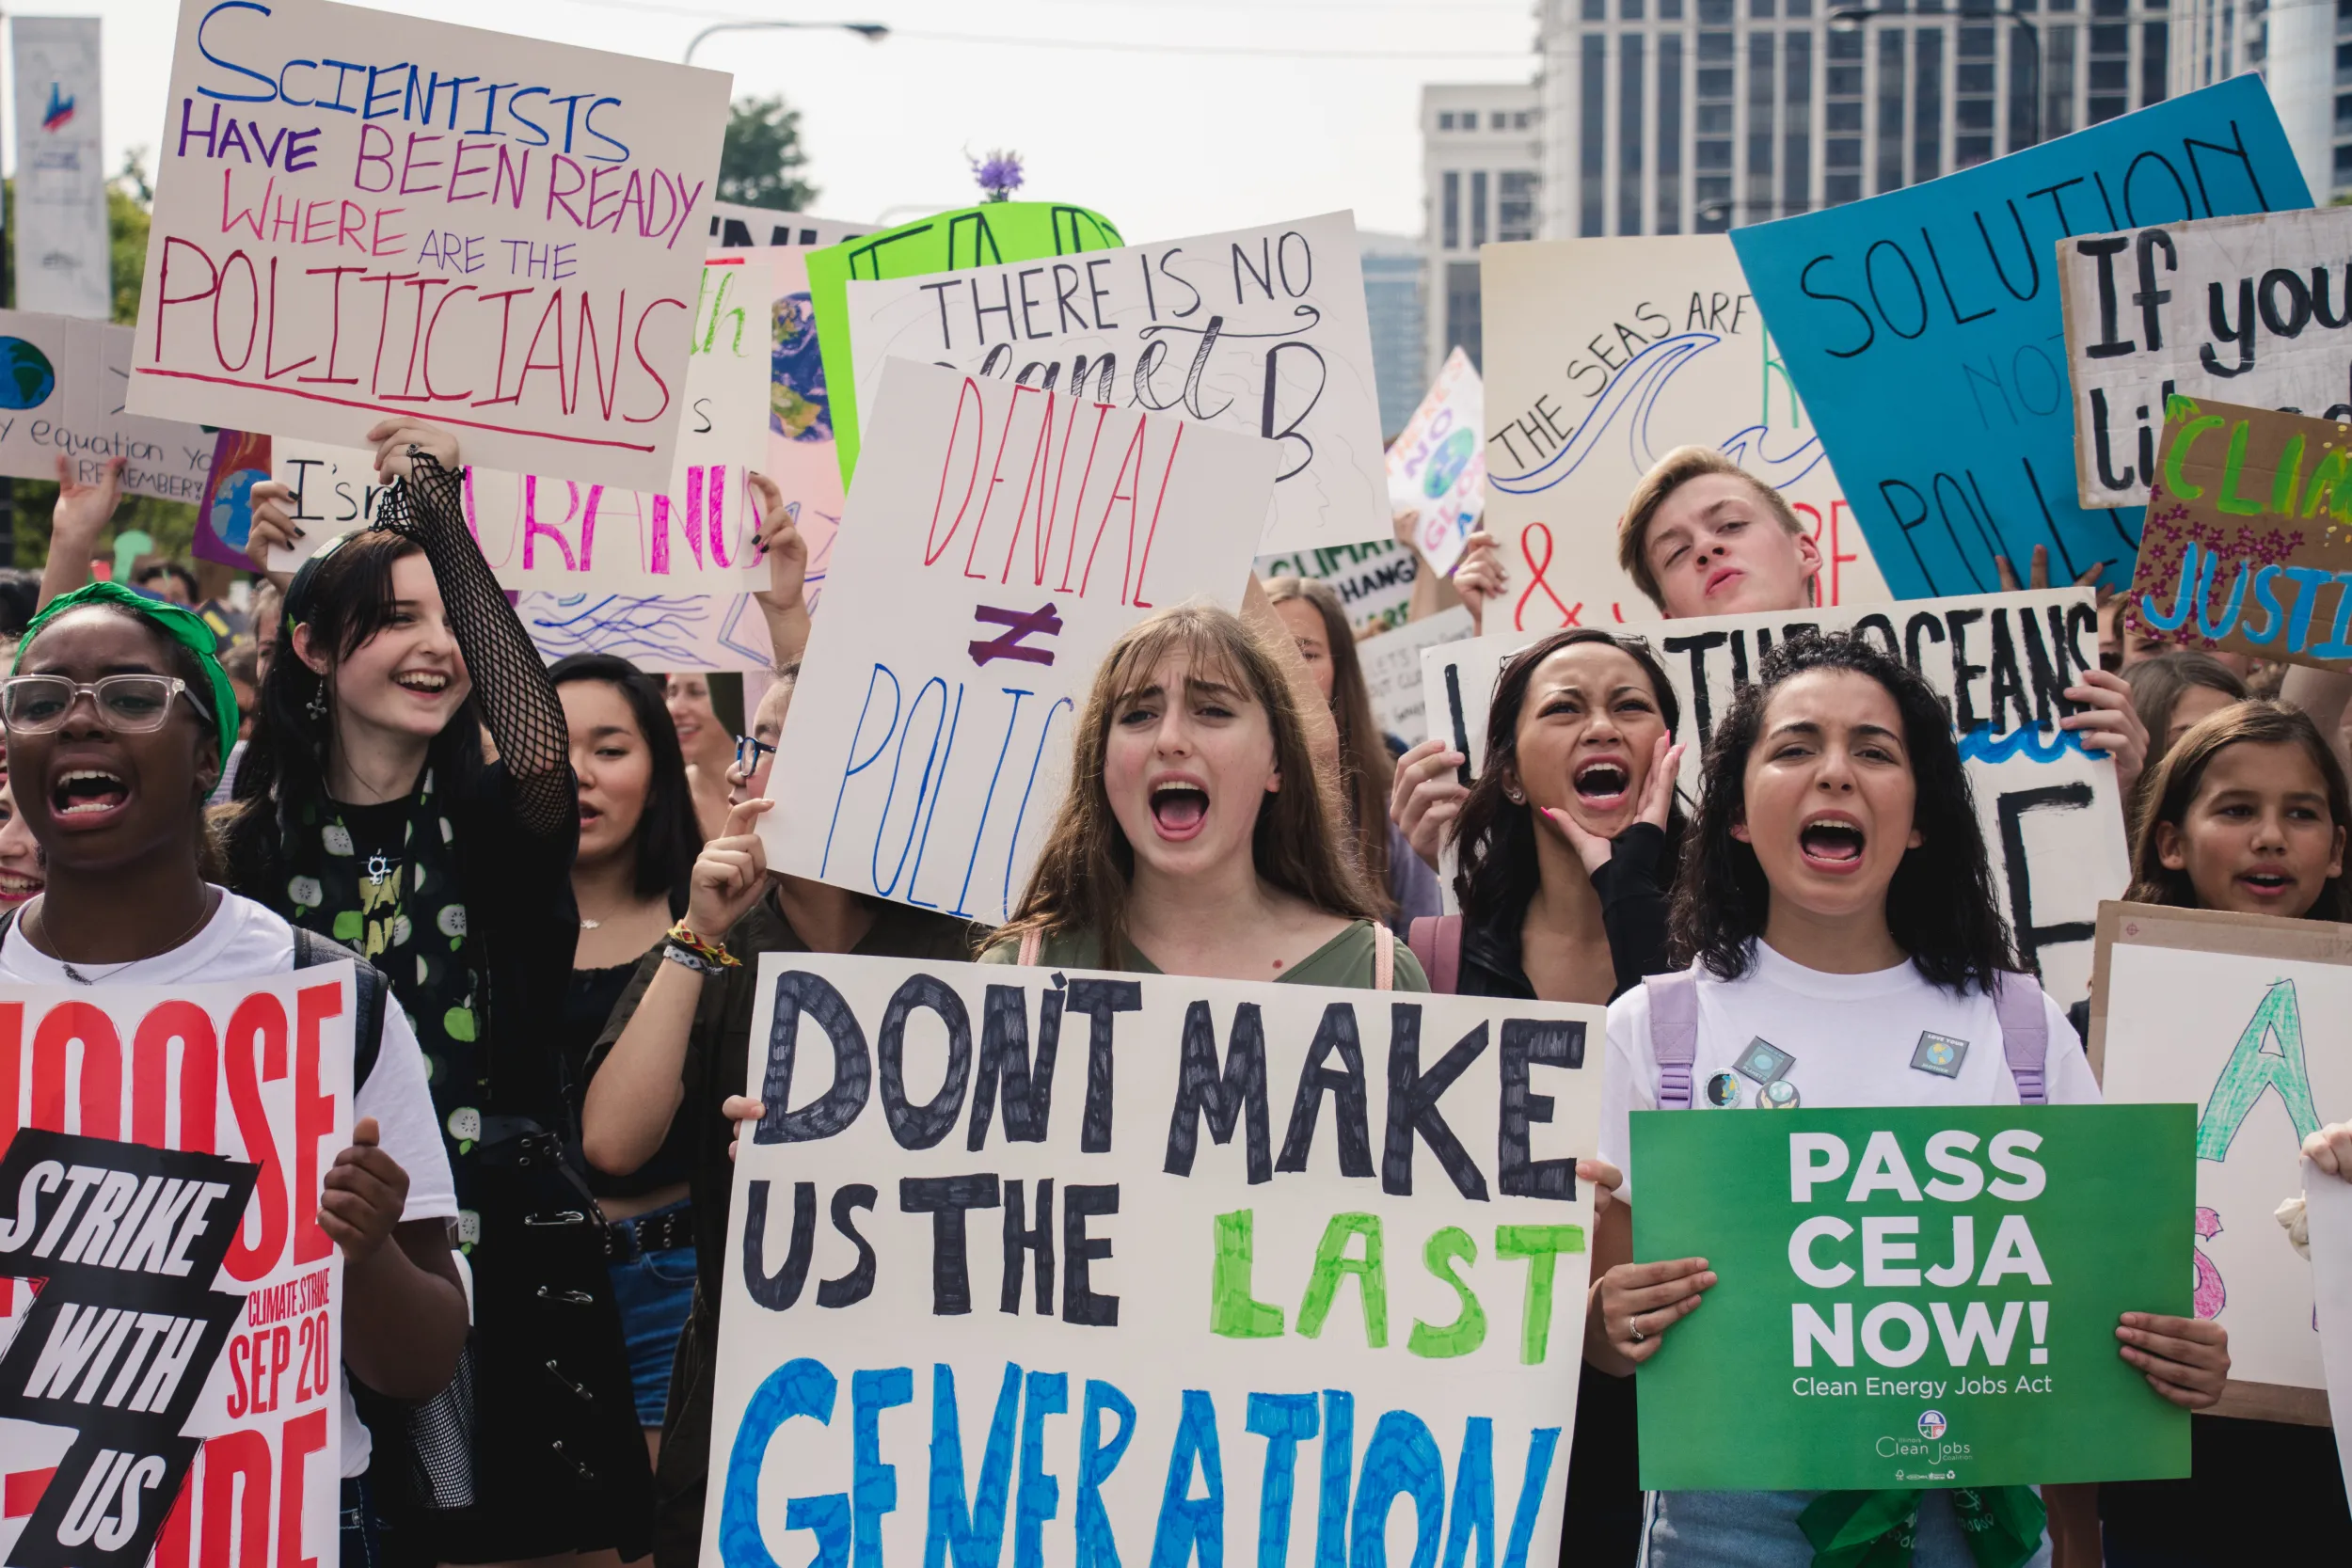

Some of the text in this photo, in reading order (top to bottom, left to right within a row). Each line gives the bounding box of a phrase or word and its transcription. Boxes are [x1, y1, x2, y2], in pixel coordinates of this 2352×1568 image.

[197, 1, 629, 163] SCIENTISTS
[179, 98, 704, 250] HAVE BEEN READY
[222, 170, 577, 279] WHERE ARE THE
[920, 231, 1311, 349] THERE IS NO
[1801, 120, 2270, 357] SOLUTION
[154, 236, 688, 423] POLITICIANS
[2076, 229, 2352, 378] If you
[1262, 341, 1326, 483] B
[1489, 292, 1754, 468] THE SEAS ARE
[1963, 333, 2064, 430] NO
[31, 420, 163, 463] equation
[924, 377, 1183, 609] DENIAL
[1340, 554, 1419, 604] HANG
[820, 664, 1074, 924] POLIC
[753, 970, 1587, 1203] DON'T MAKE
[1927, 1034, 1964, 1047] LOVE YOUR
[0, 980, 344, 1284] OOSE
[1788, 1130, 2047, 1203] PASS
[0, 1160, 231, 1277] STRIKE
[743, 1173, 1586, 1366] US THE LAST
[1788, 1214, 2052, 1289] CEJA
[247, 1267, 331, 1329] CLIMATE STRIKE
[1791, 1301, 2050, 1368] NOW!
[23, 1303, 208, 1414] WITH
[227, 1310, 330, 1420] SEP 20
[1792, 1375, 2052, 1399] Clean Energy Jobs Act
[56, 1449, 167, 1552] US
[719, 1357, 1562, 1568] GENERATION
[1876, 1436, 1970, 1465] Clean Jobs
